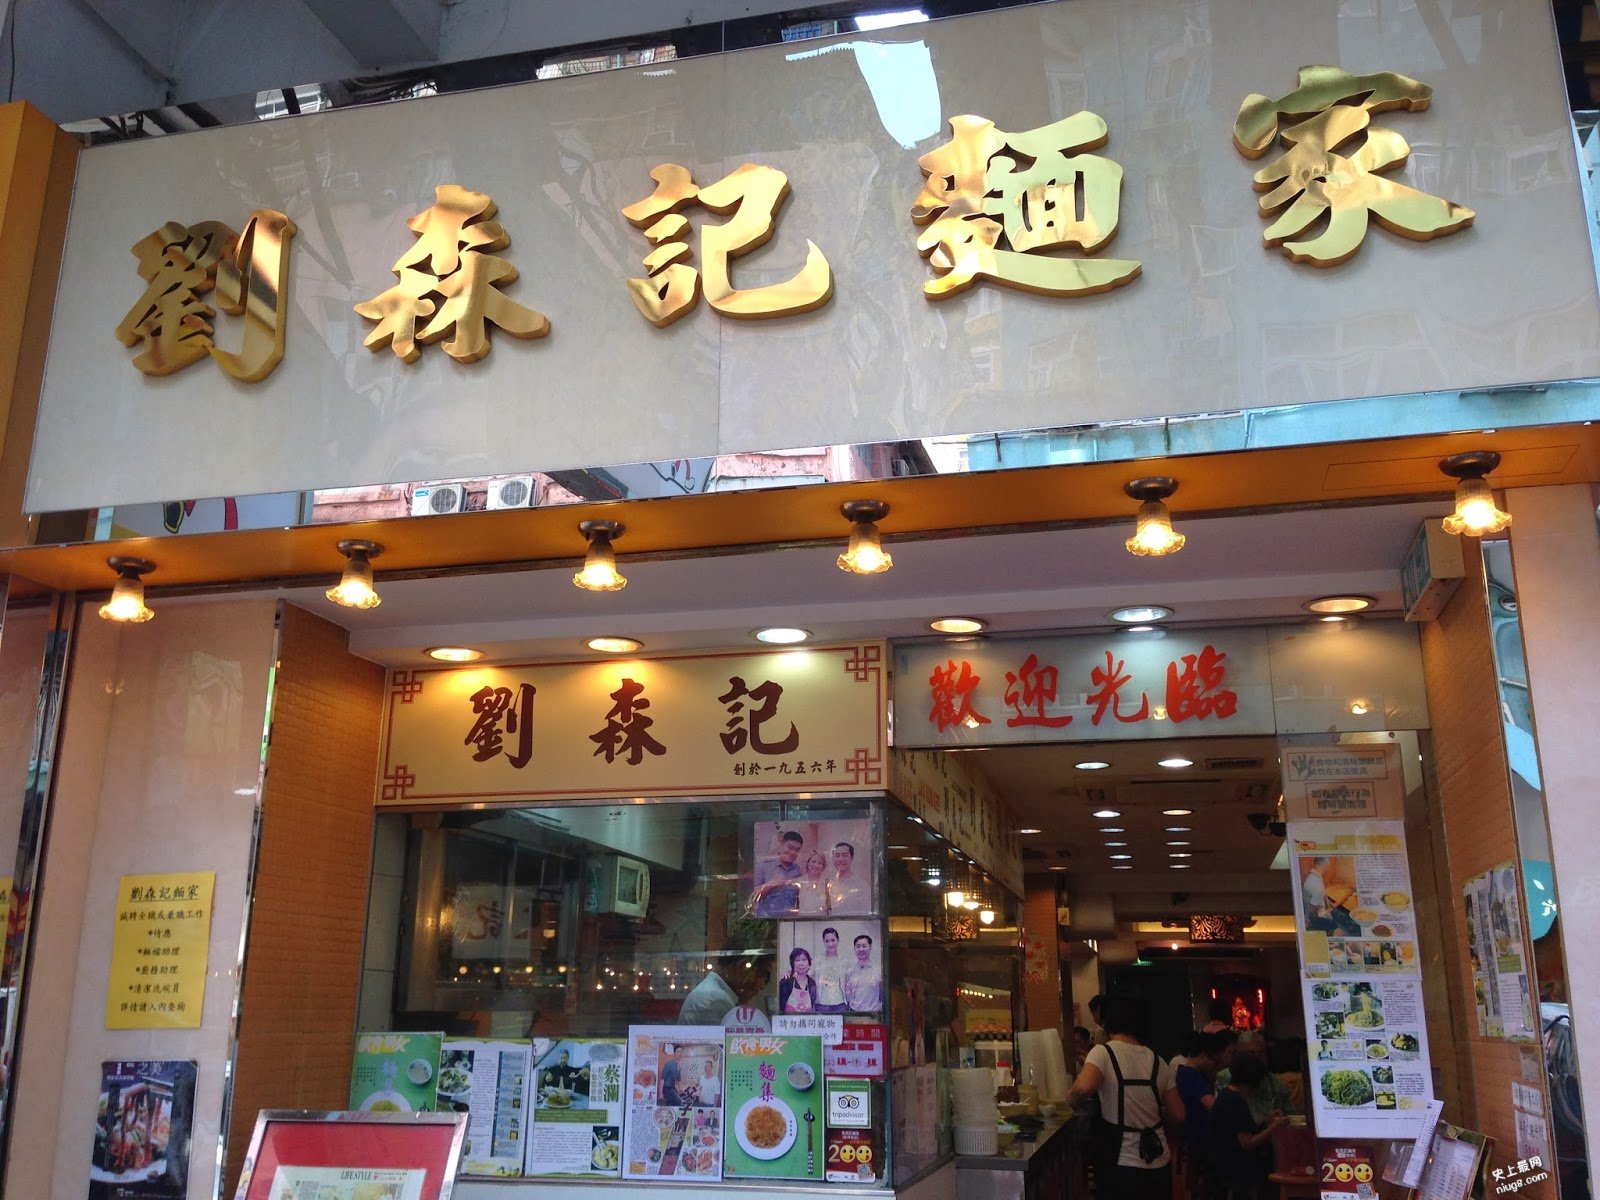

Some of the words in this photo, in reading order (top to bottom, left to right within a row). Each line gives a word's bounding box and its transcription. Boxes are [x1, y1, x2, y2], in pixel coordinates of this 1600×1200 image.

[928, 645, 1238, 733] 歡迎光臨
[464, 676, 800, 769] 劉森記
[732, 759, 838, 776] 創於一九五六年
[832, 1111, 864, 1119] tripadvisor
[340, 1170, 373, 1181] LIFESTYLE
